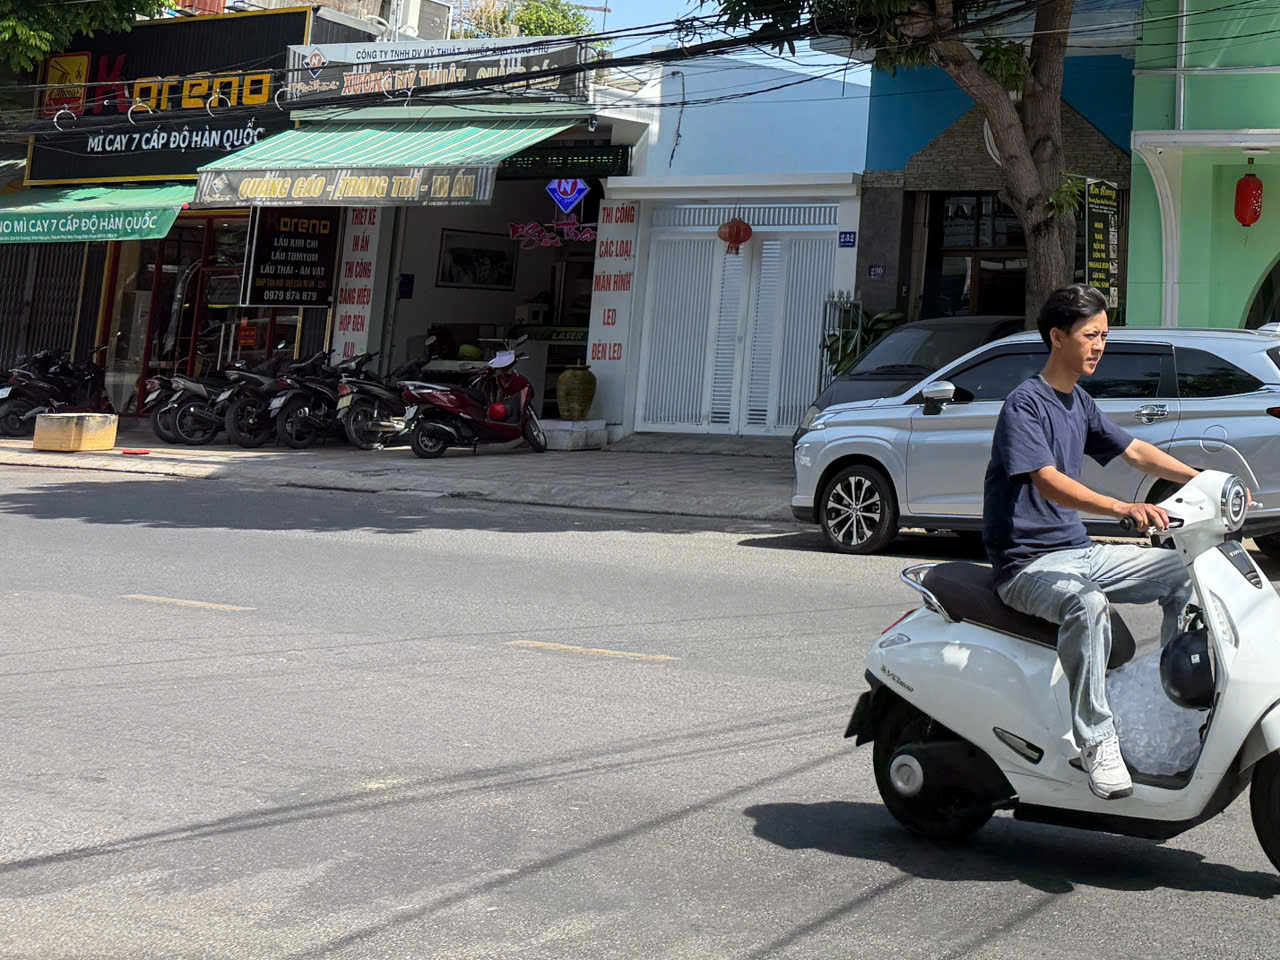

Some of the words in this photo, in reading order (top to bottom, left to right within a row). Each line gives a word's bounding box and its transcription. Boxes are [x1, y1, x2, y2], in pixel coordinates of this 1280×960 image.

[356, 48, 377, 60] CÔNG
[379, 49, 389, 59] TY
[390, 49, 410, 58] TNHH
[412, 48, 422, 57] DV
[93, 53, 272, 114] Koreno
[105, 134, 128, 151] CAY
[131, 133, 141, 150] 7
[141, 125, 167, 150] CẤP
[169, 124, 190, 152] ĐỘ
[191, 125, 221, 147] HÀN
[223, 117, 265, 151] QUỐC
[431, 175, 450, 198] IN
[14, 216, 27, 233] MÌ
[28, 219, 49, 233] CAY
[51, 219, 57, 232] 7
[59, 214, 79, 232] CẤP
[80, 214, 98, 233] ĐỘ
[100, 214, 123, 231] HÀN
[125, 211, 158, 231] QUỐC
[602, 207, 613, 224] THI
[615, 203, 635, 224] CÔNG
[600, 236, 614, 257] CÁC
[615, 240, 632, 261] LOẠI
[602, 309, 617, 326] LED
[592, 339, 607, 361] ĐÈN
[608, 343, 622, 360] LED
